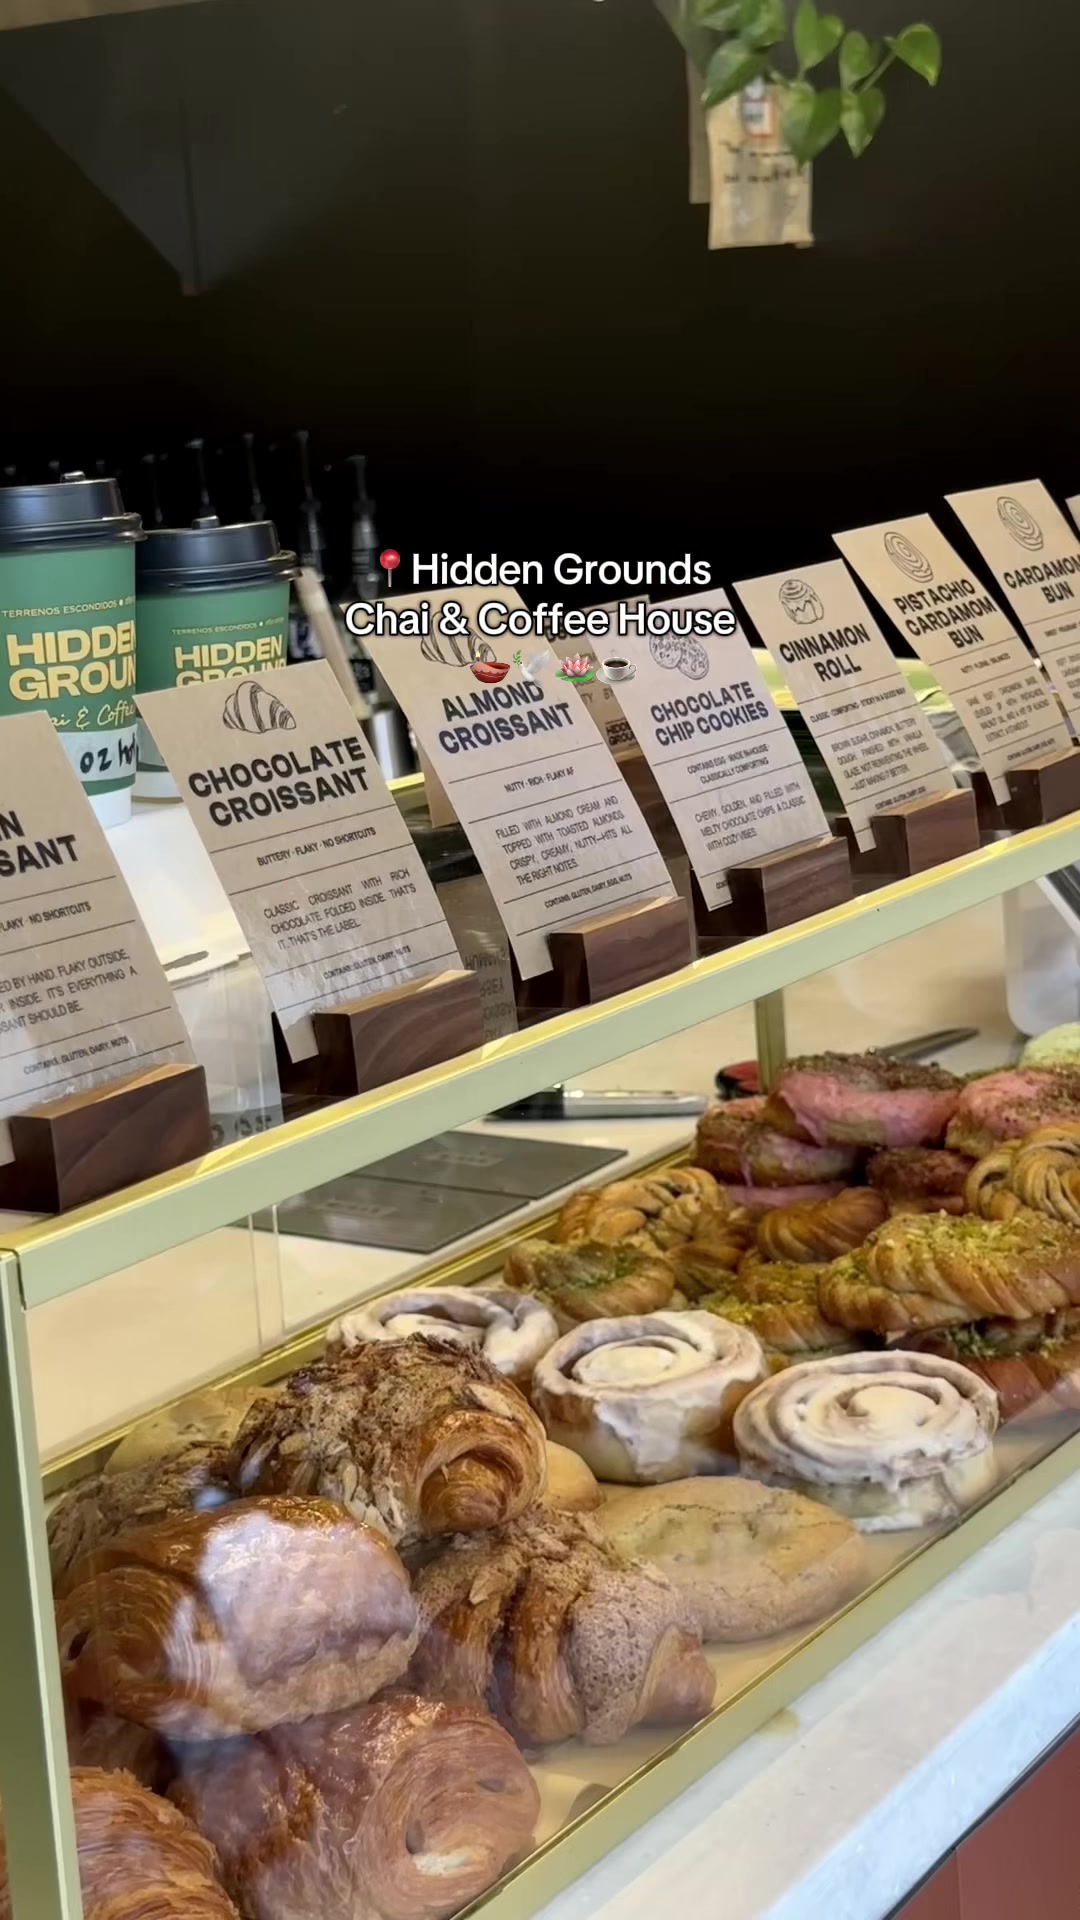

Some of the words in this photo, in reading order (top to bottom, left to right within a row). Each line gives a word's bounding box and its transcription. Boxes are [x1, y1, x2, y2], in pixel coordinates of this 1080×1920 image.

[2, 607, 60, 618] TERRENOS
[63, 600, 117, 614] ESCONDIDOS
[893, 578, 975, 615] PISTACHIO
[1041, 581, 1075, 604] BUN
[905, 597, 998, 637] CARDAMOM
[174, 634, 282, 669] HIDDEN
[779, 623, 871, 664] CINNAMON
[947, 624, 985, 649] BUN
[813, 653, 862, 683] ROLL
[76, 705, 90, 730] &
[441, 681, 545, 722] ALMOND
[650, 681, 756, 724] CHOCOLATE
[438, 702, 575, 755] CROISSANT
[655, 718, 696, 746] CHIP
[699, 700, 770, 735] COOKIES
[188, 735, 366, 798] CHOCOLATE
[504, 780, 525, 793] NUTTY
[527, 775, 544, 787] RICH
[545, 770, 565, 782] FLAKY
[565, 766, 575, 776] AF
[700, 768, 735, 784] CLASSICALLY
[735, 757, 769, 773] COMFORTING
[209, 766, 369, 828] CROISSANT
[495, 824, 521, 840] FILLED
[522, 819, 543, 832] WITH
[544, 808, 574, 824] ALMOND
[576, 800, 602, 816] CREAM
[603, 795, 619, 808] AND
[501, 838, 532, 855] TOPPED
[534, 832, 555, 845] WITH
[556, 820, 589, 838] TOASTED
[592, 809, 625, 827] ALMONDS
[621, 824, 634, 835] ALL
[722, 812, 757, 831] CHOCOLATE
[0, 834, 79, 877] SANT
[256, 849, 292, 866] BUTTERY
[295, 841, 319, 856] FLAKY
[322, 838, 335, 849] NO
[334, 826, 377, 845] SHORTCUTS
[263, 900, 300, 919] CLASSIC
[308, 884, 353, 906] CROISSANT
[361, 876, 383, 890] WITH
[390, 868, 411, 883] RICH
[516, 874, 533, 886] THE
[532, 866, 554, 881] RIGHT
[29, 913, 42, 925] NO
[42, 901, 92, 922] SHORTCUTS
[270, 911, 322, 935] CHOCOLATE
[324, 901, 357, 919] FOLDED
[388, 883, 417, 899] THAT'S
[289, 930, 318, 948] THAT'S
[319, 925, 336, 938] THE
[13, 976, 27, 990] BY
[57, 959, 86, 978] FLAKY
[87, 948, 131, 969] OUTSIDE,
[47, 985, 65, 1000] IT'S
[68, 969, 126, 995] EVERYTHING
[129, 965, 138, 977] A
[28, 1004, 67, 1025] SHOULD
